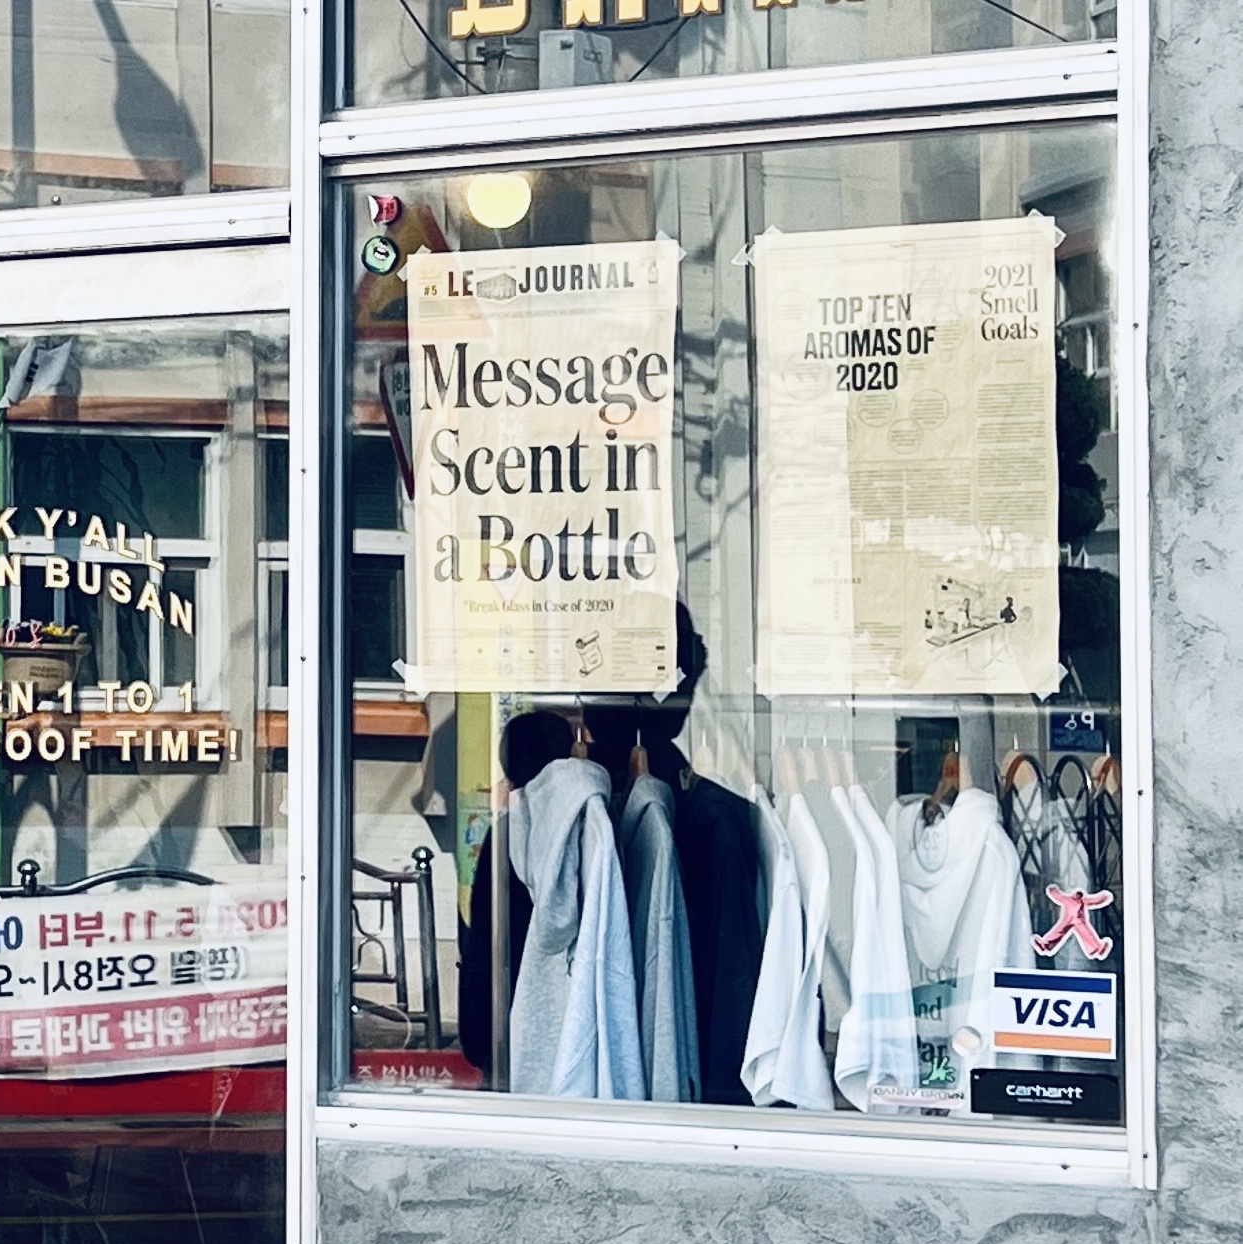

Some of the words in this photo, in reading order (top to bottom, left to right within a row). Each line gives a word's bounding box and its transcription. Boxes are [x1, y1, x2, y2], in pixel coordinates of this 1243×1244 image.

[447, 269, 474, 297] LE
[518, 261, 635, 293] JOURNAL
[984, 263, 1033, 288] 2021
[818, 297, 863, 325] TOP
[868, 293, 912, 322] TEN
[980, 288, 1039, 315] Smell
[804, 328, 902, 359] AROMAS
[907, 326, 937, 354] OF
[980, 316, 1039, 341] Goals
[420, 342, 668, 425] Message
[836, 361, 898, 391] 2020
[430, 428, 591, 496] Scent
[604, 428, 661, 492] in
[35, 506, 166, 573] Y'ALL
[433, 533, 464, 583] a
[477, 508, 657, 582] Bottle
[45, 556, 194, 635] BUSAN
[57, 681, 73, 714] 1
[99, 681, 155, 714] TO
[179, 681, 195, 712] 1
[116, 729, 241, 761] TIME!
[1010, 996, 1096, 1029] VISA
[1006, 1084, 1084, 1099] carhartt
